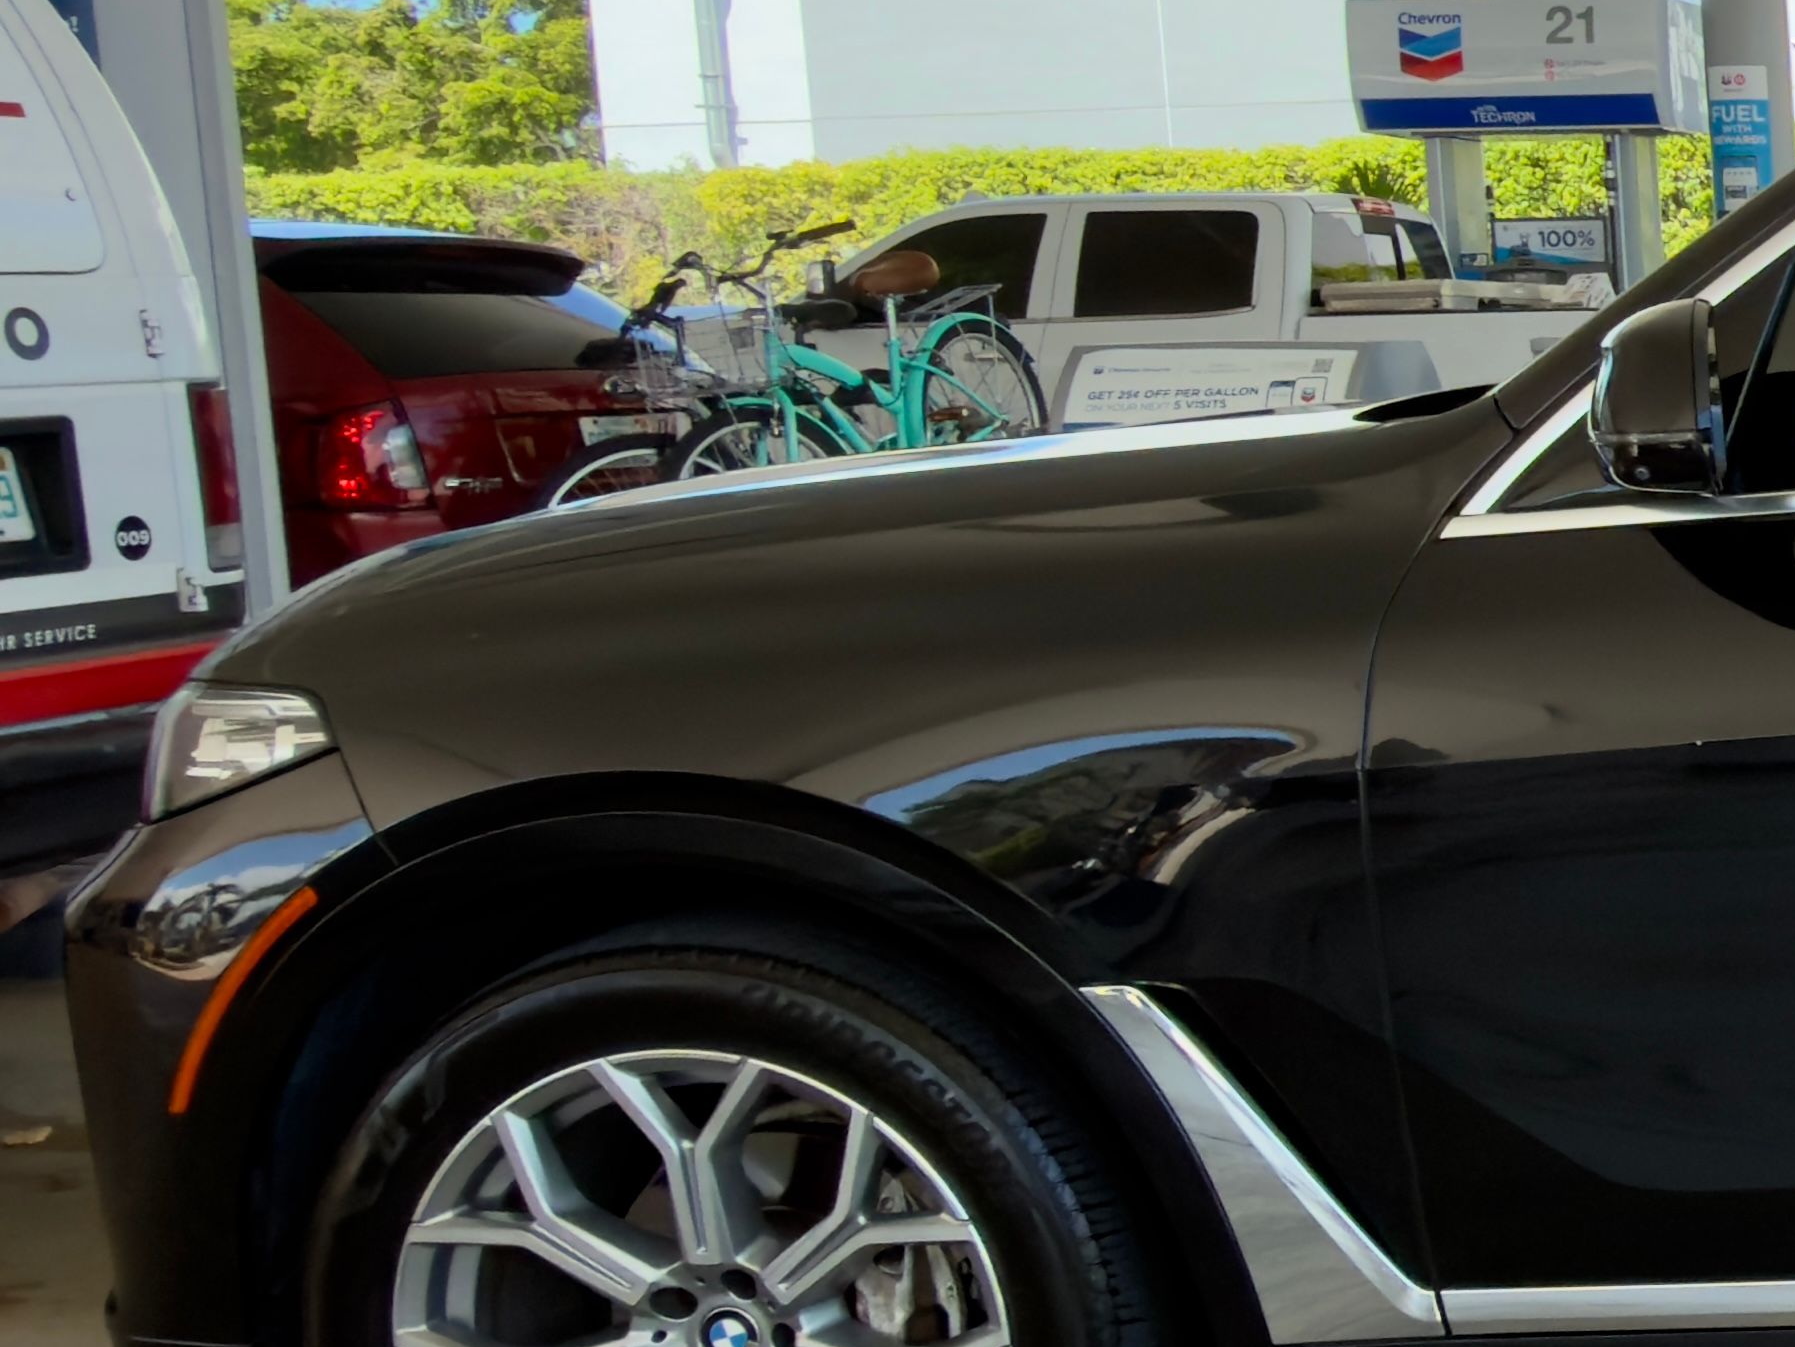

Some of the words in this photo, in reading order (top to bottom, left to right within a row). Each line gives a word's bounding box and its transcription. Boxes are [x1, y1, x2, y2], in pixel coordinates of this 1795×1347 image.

[1398, 12, 1461, 25] Chevron
[1545, 6, 1595, 44] 21
[1711, 104, 1766, 123] FUEL
[1537, 230, 1596, 248] 100%
[1088, 390, 1114, 400] GET
[1144, 389, 1171, 399] OFF
[1174, 388, 1200, 398] PER
[1204, 387, 1258, 397] GALLON
[1186, 399, 1227, 409] VISITS
[116, 529, 151, 547] 009
[24, 623, 97, 648] SERVICE
